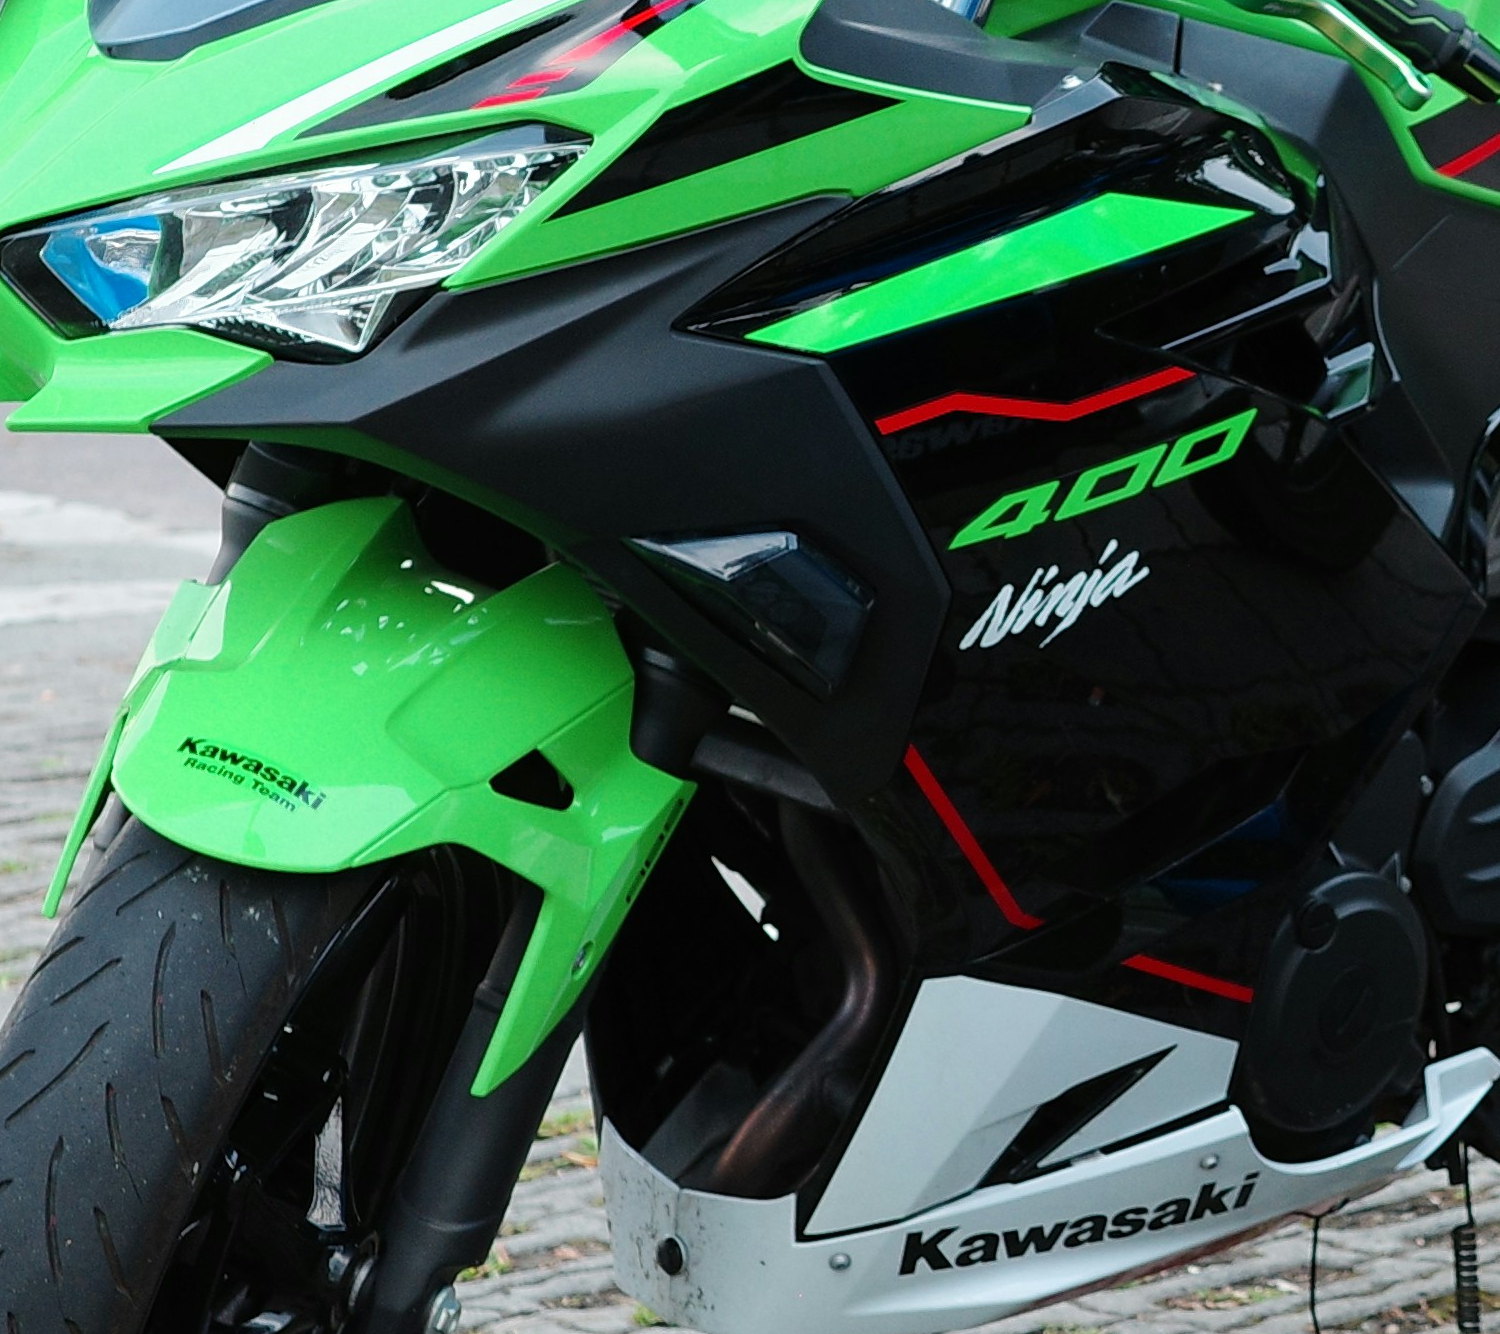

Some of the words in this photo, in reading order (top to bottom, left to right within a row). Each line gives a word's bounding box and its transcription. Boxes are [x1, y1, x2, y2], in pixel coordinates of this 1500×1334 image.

[948, 407, 1258, 550] 400
[958, 538, 1150, 650] Ninja
[177, 737, 327, 811] Kawasaki
[183, 757, 246, 785] Racing
[251, 778, 296, 812] Team
[899, 1171, 1260, 1276] Kawasaki
